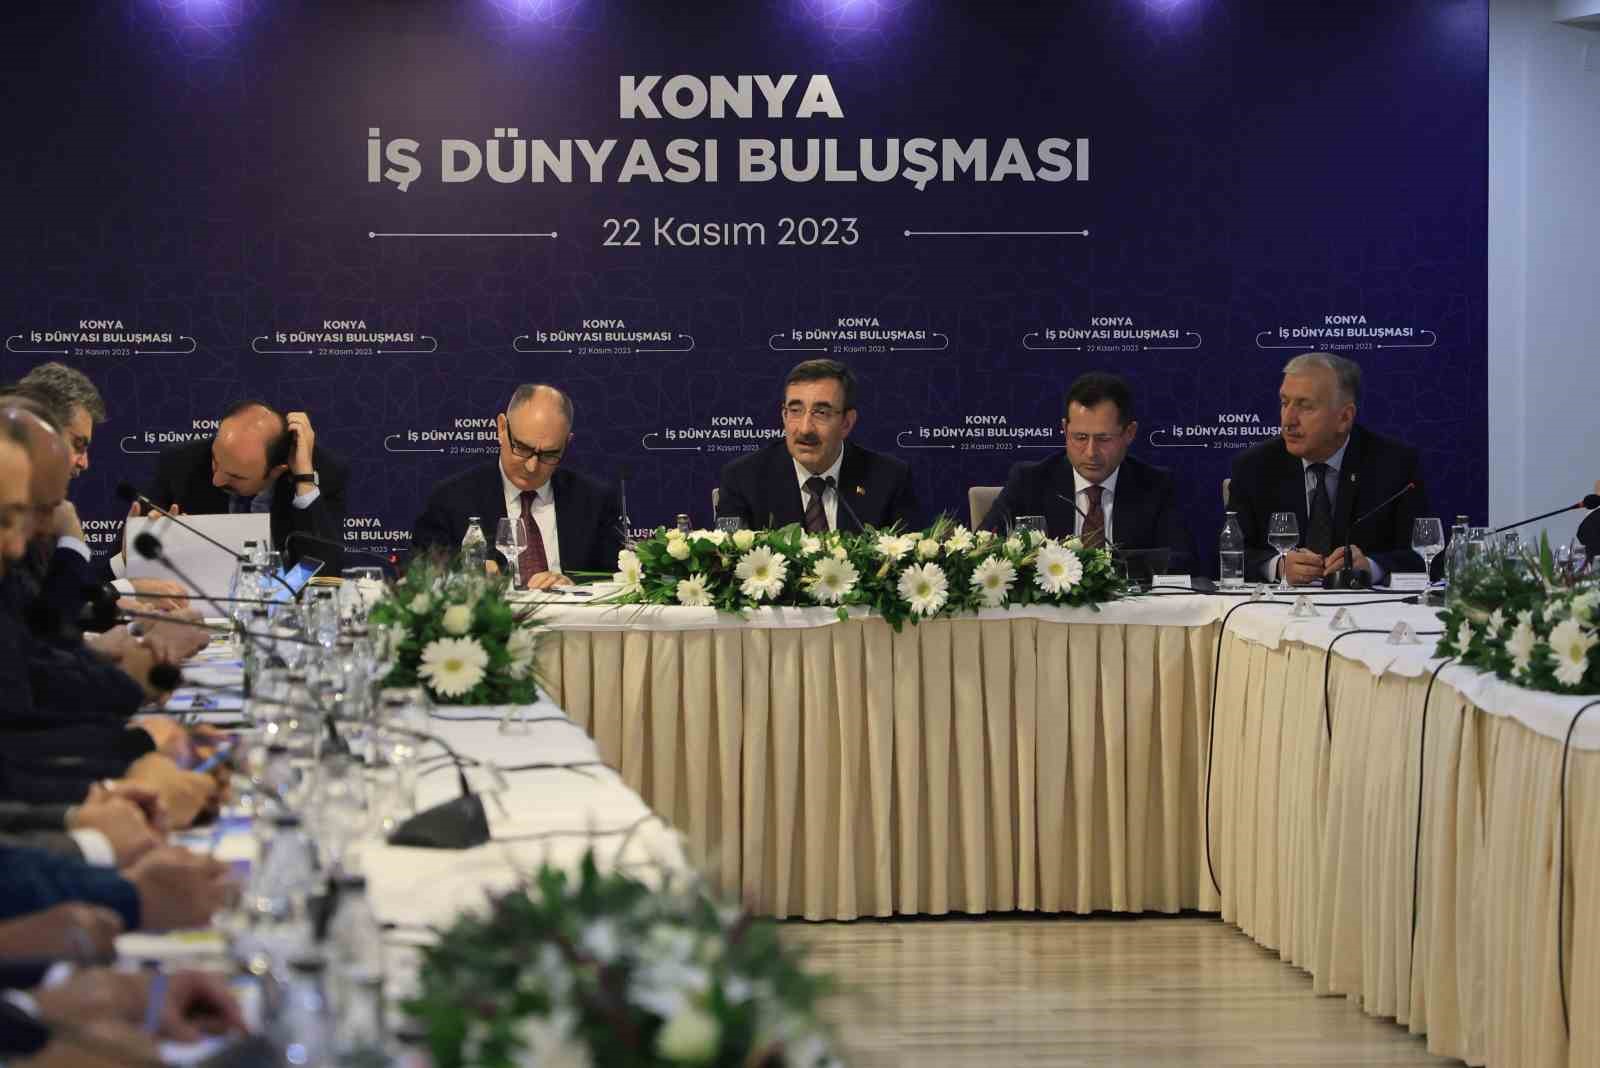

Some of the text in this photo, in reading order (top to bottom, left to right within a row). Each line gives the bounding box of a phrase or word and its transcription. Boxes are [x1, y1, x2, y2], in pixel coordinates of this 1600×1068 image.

[619, 74, 844, 119] KONYA
[367, 127, 1091, 192] İŞ DÜNYASI BULUŞMASI
[602, 216, 861, 248] 22 Kasım 2023
[80, 320, 123, 329] KONYA
[323, 320, 366, 329] KONYA
[583, 319, 625, 328] KONYA
[838, 318, 880, 327] KONYA
[1091, 317, 1133, 326] KONYA
[1325, 315, 1367, 325] KONYA
[31, 330, 172, 344] İŞ DÜNYASI BULUŞMASI
[276, 331, 414, 343] İŞ DÜNYASI BULUŞMASI
[537, 331, 671, 343] İŞ DÜNYASI BULUŞMASI
[792, 329, 925, 342] İŞ DÜNYASI BULUŞMASI
[1046, 328, 1179, 341] İŞ DÜNYASI BULUŞMASI
[1279, 326, 1413, 339] İŞ DÜNYASI BULUŞMASI
[192, 420, 220, 429] KON
[455, 418, 498, 428] KONYA
[712, 416, 753, 426] KONYA
[965, 416, 1007, 425] KONYA
[1218, 414, 1260, 423] KONYA
[408, 430, 418, 442] İŞ
[422, 430, 474, 440] DÜNYASI
[666, 428, 676, 440] İŞ
[679, 428, 731, 439] DÜNYASI
[920, 426, 1052, 438] İŞ DÜNYASI BULUŞMASI
[1173, 425, 1183, 437] İŞ
[1187, 425, 1237, 436] DÜNYASI
[144, 432, 155, 444] İŞ
